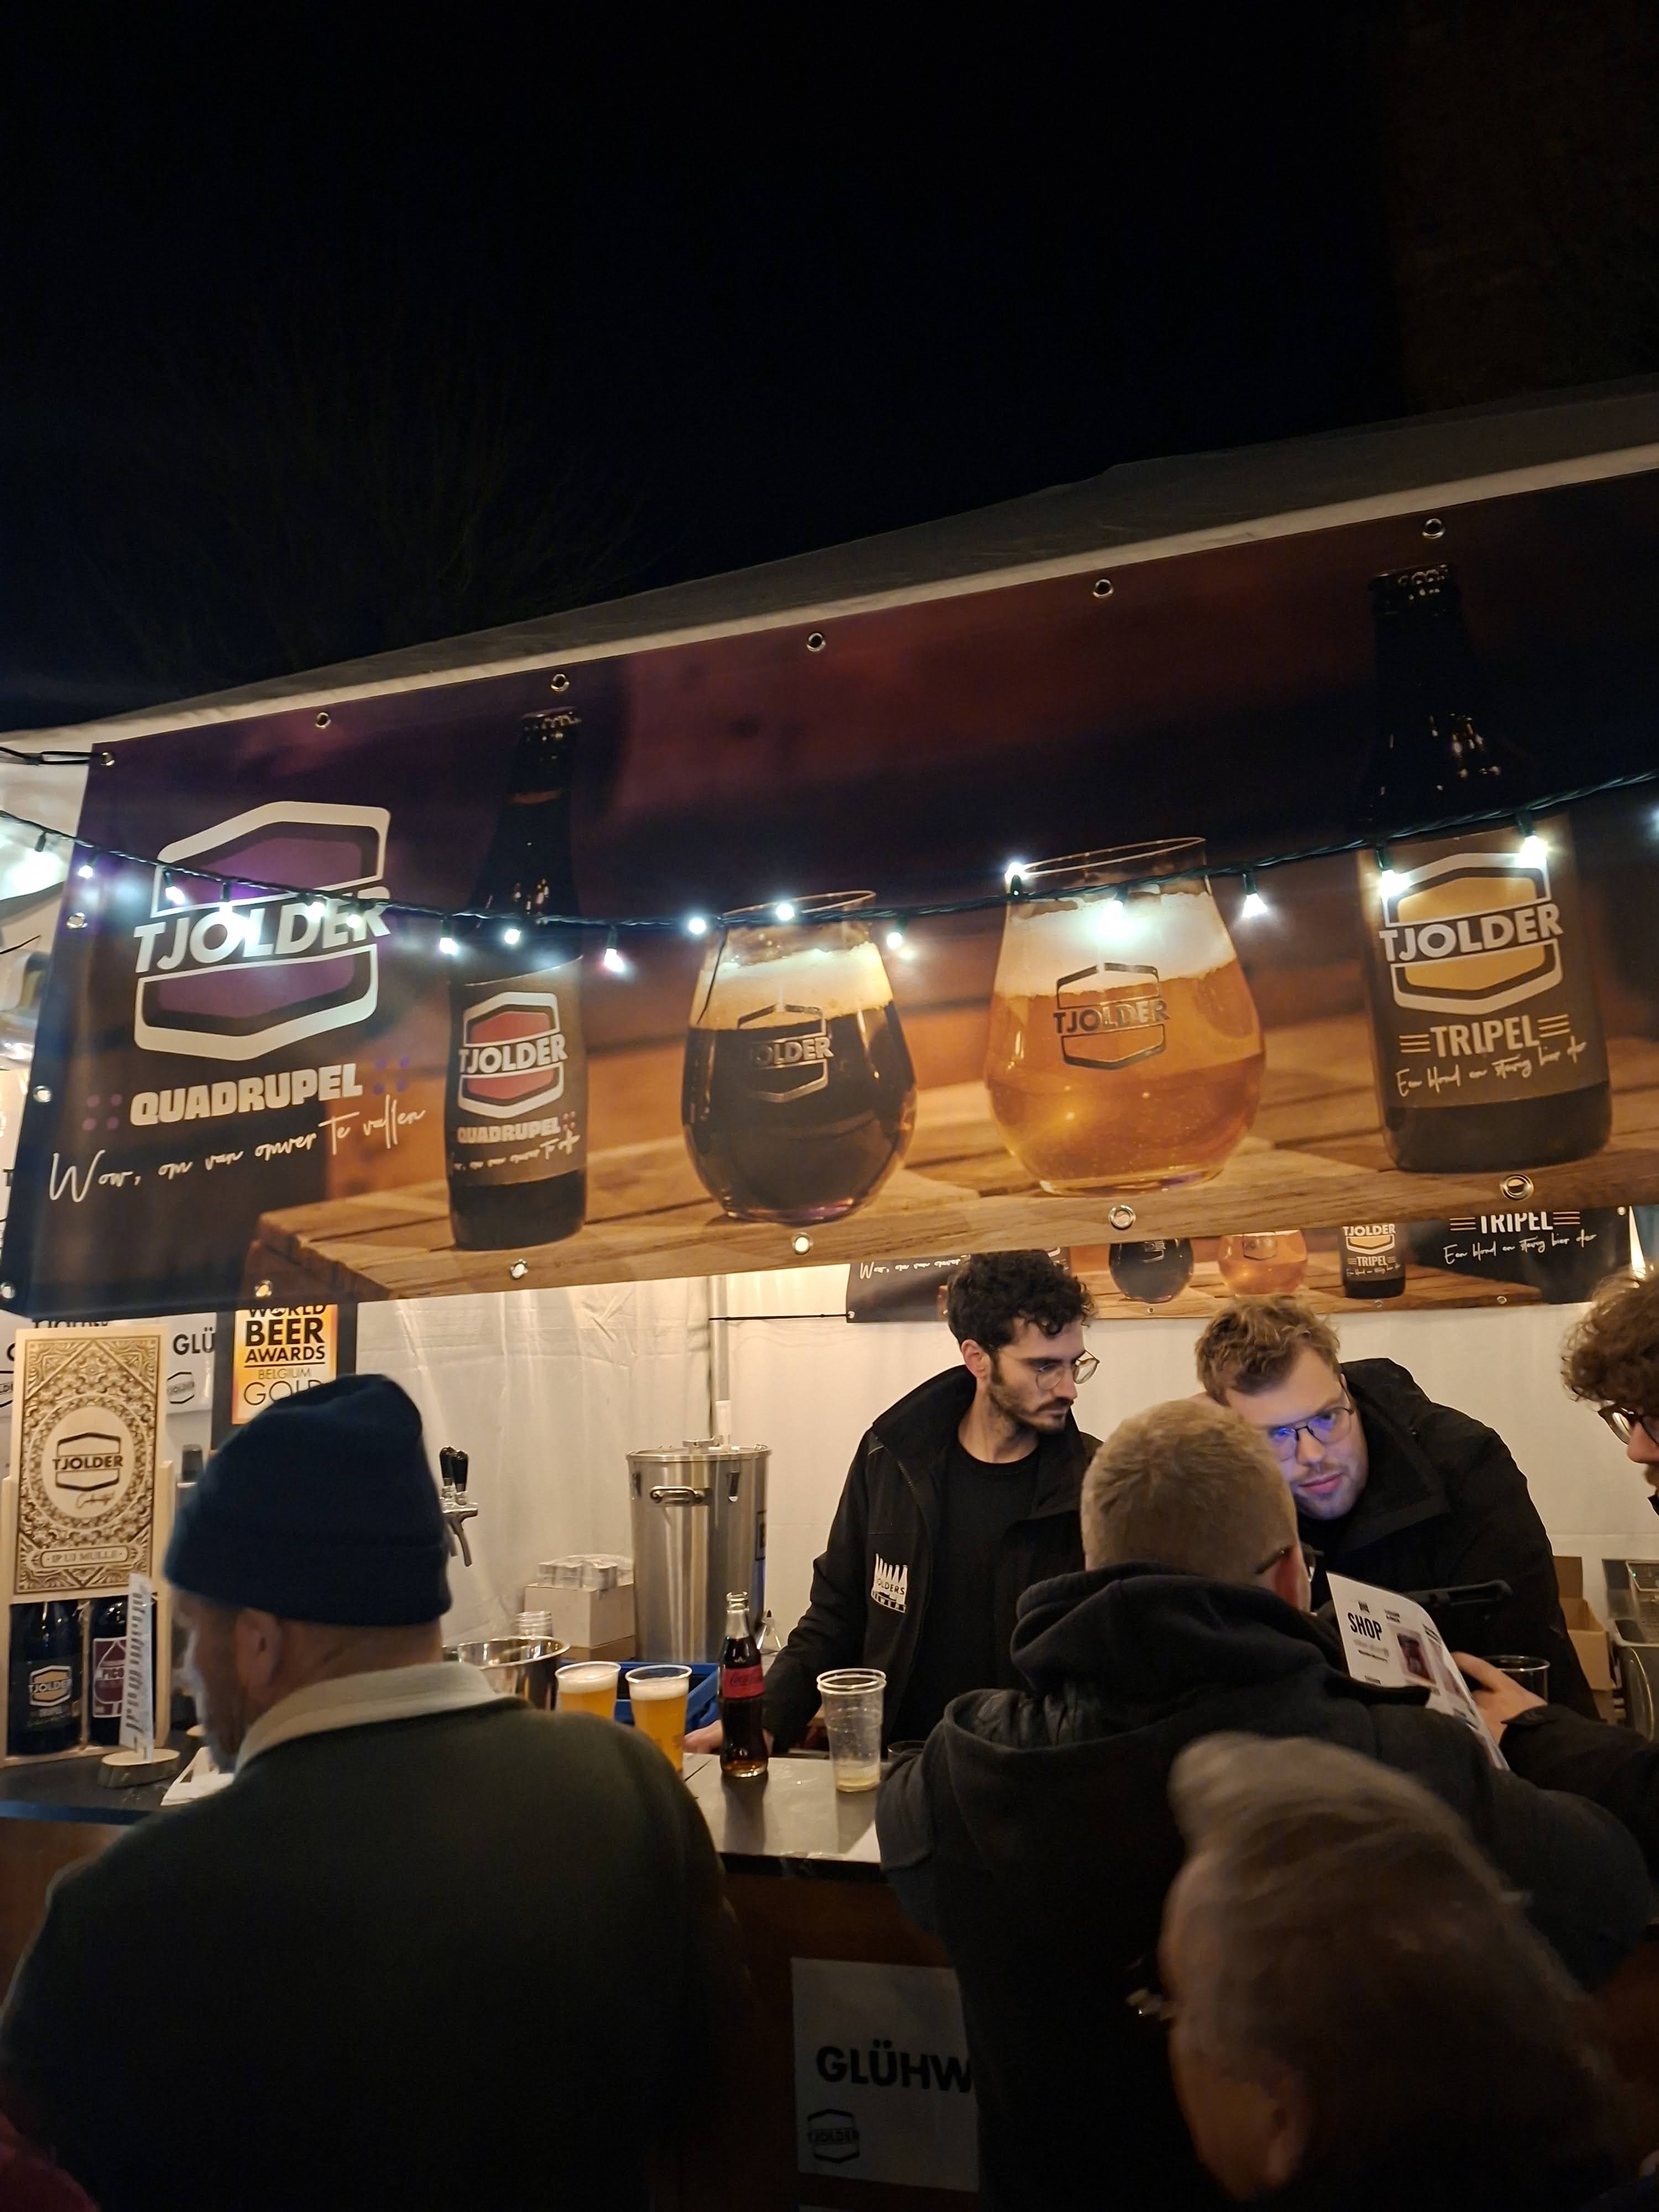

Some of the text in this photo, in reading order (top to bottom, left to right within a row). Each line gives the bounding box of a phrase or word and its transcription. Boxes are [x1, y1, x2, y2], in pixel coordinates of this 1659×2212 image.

[134, 886, 392, 973] TJOLDER
[1379, 903, 1564, 962] TJOLDER
[1053, 999, 1171, 1034] TJOLDER
[1430, 1015, 1540, 1057] TRIPEL
[458, 1034, 568, 1074] TJOLDER
[751, 1036, 835, 1067] OLDER
[131, 1062, 363, 1126] QUADRUPEL
[158, 1160, 192, 1180] om
[205, 1150, 244, 1171] van
[254, 1131, 317, 1161] omver
[363, 1094, 426, 1149] vallen
[457, 1117, 561, 1144] QUADRUPEL
[1343, 1224, 1396, 1237] TJOLDER
[1480, 1211, 1553, 1234] TRIPEL
[1357, 1256, 1388, 1266] TRIPEL
[173, 1327, 215, 1355] GLÜ
[246, 1317, 325, 1347] BEER
[244, 1345, 325, 1363] AWARDS
[258, 1368, 311, 1380] BELGIUM
[52, 1455, 123, 1470] TJOLDER
[1347, 1611, 1383, 1641] SHOP
[816, 2039, 972, 2093] GLÜHW
